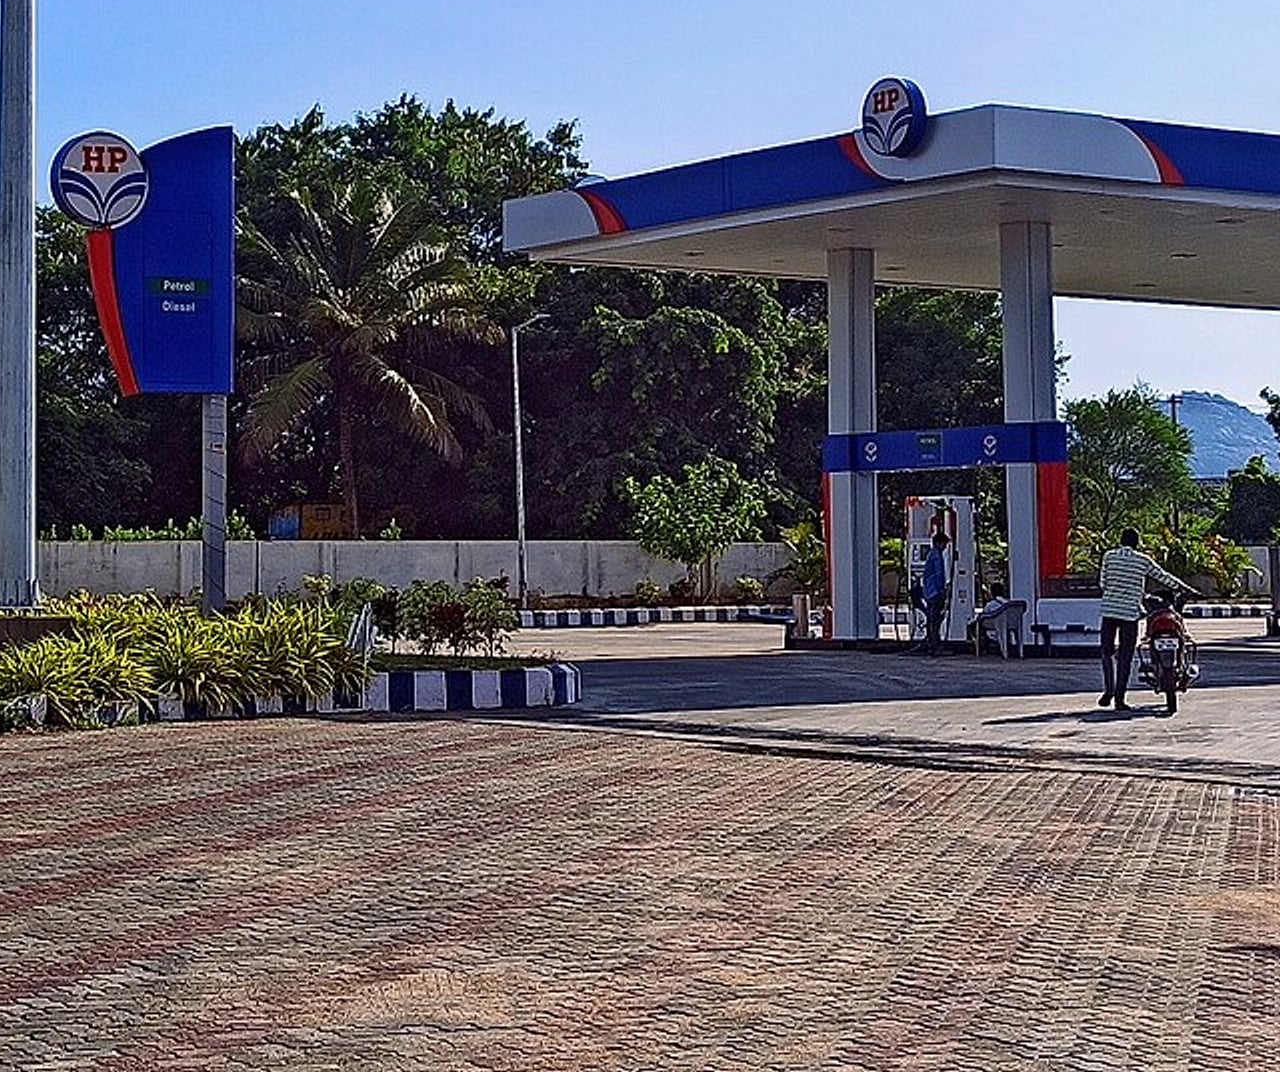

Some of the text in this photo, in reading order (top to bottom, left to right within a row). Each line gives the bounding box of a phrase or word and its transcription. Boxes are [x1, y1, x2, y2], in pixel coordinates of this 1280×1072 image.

[872, 88, 900, 114] HP
[81, 145, 128, 173] HP
[163, 279, 196, 292] Petrol
[162, 299, 196, 312] Diesel
